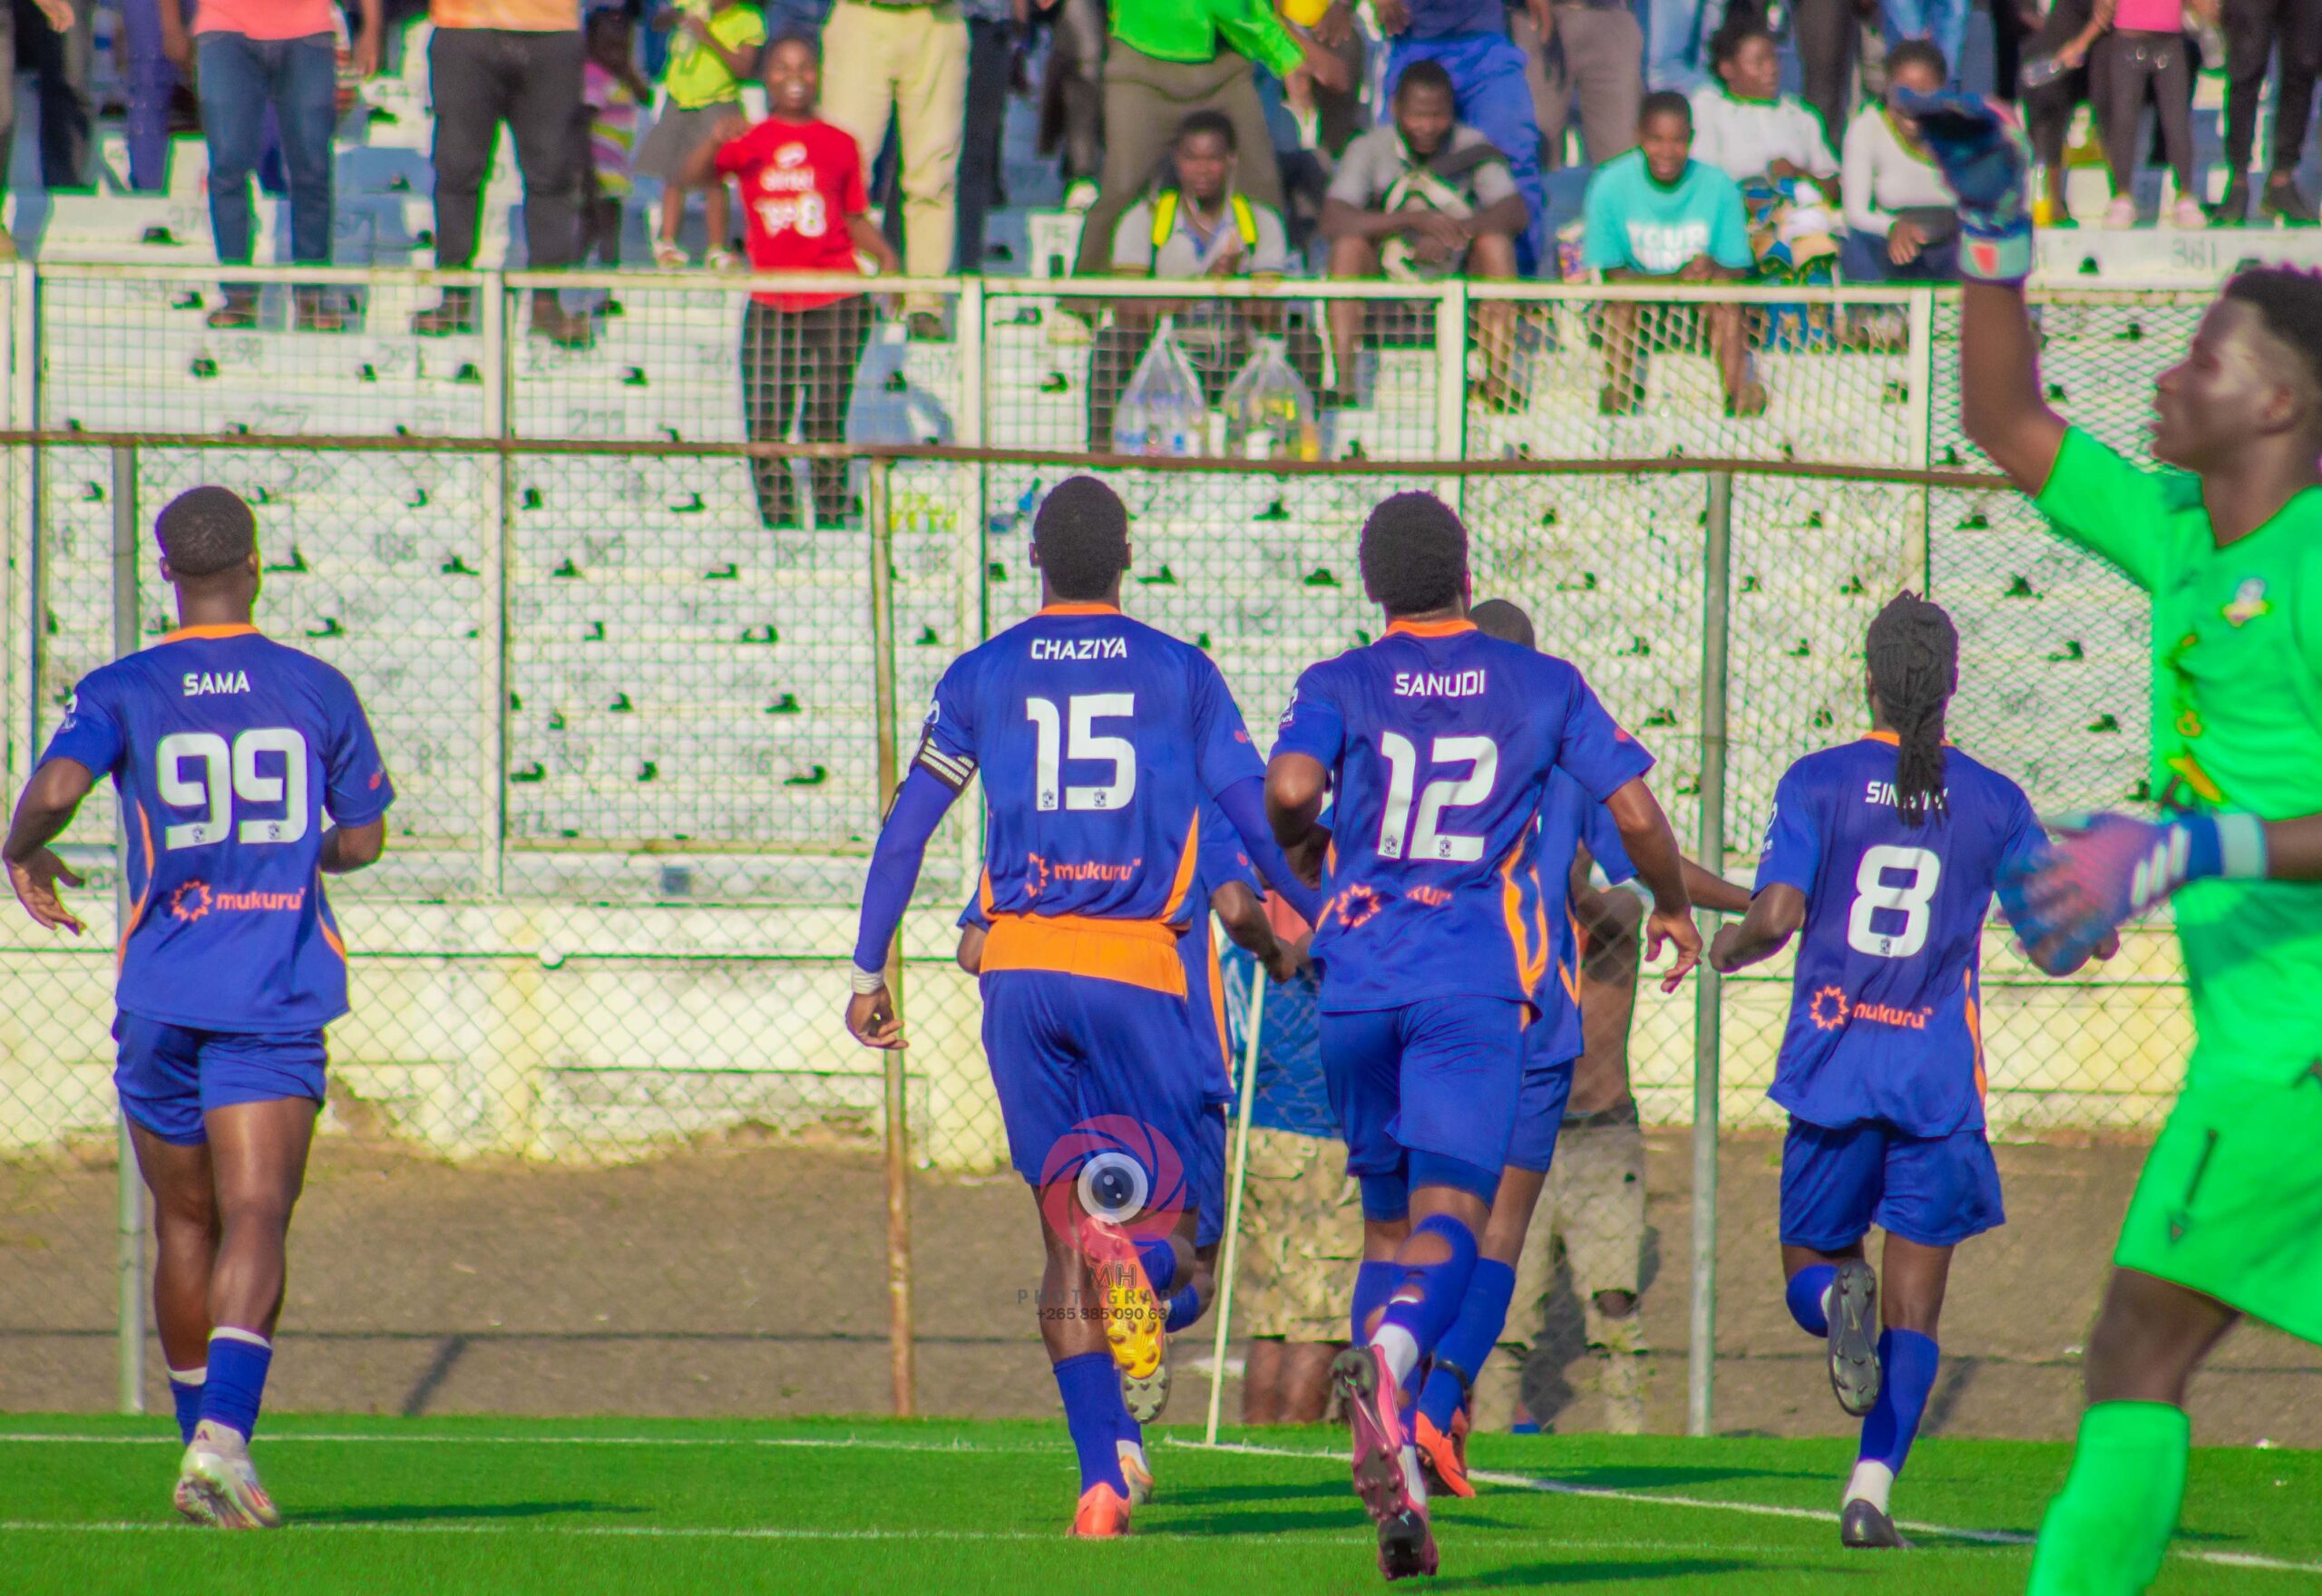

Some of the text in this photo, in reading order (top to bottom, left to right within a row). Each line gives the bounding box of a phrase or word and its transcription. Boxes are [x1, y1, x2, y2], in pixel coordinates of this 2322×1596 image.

[1626, 221, 1708, 249] YOUR
[1031, 637, 1127, 660] CHAZIYA
[183, 670, 251, 696] SAMA
[1394, 669, 1486, 697] SANUDI
[1027, 693, 1137, 812] 15
[157, 727, 308, 851] 99
[1377, 731, 1498, 862] 12
[1054, 861, 1132, 881] mukuru
[217, 890, 302, 911] mukuru
[1848, 844, 1942, 959] 8
